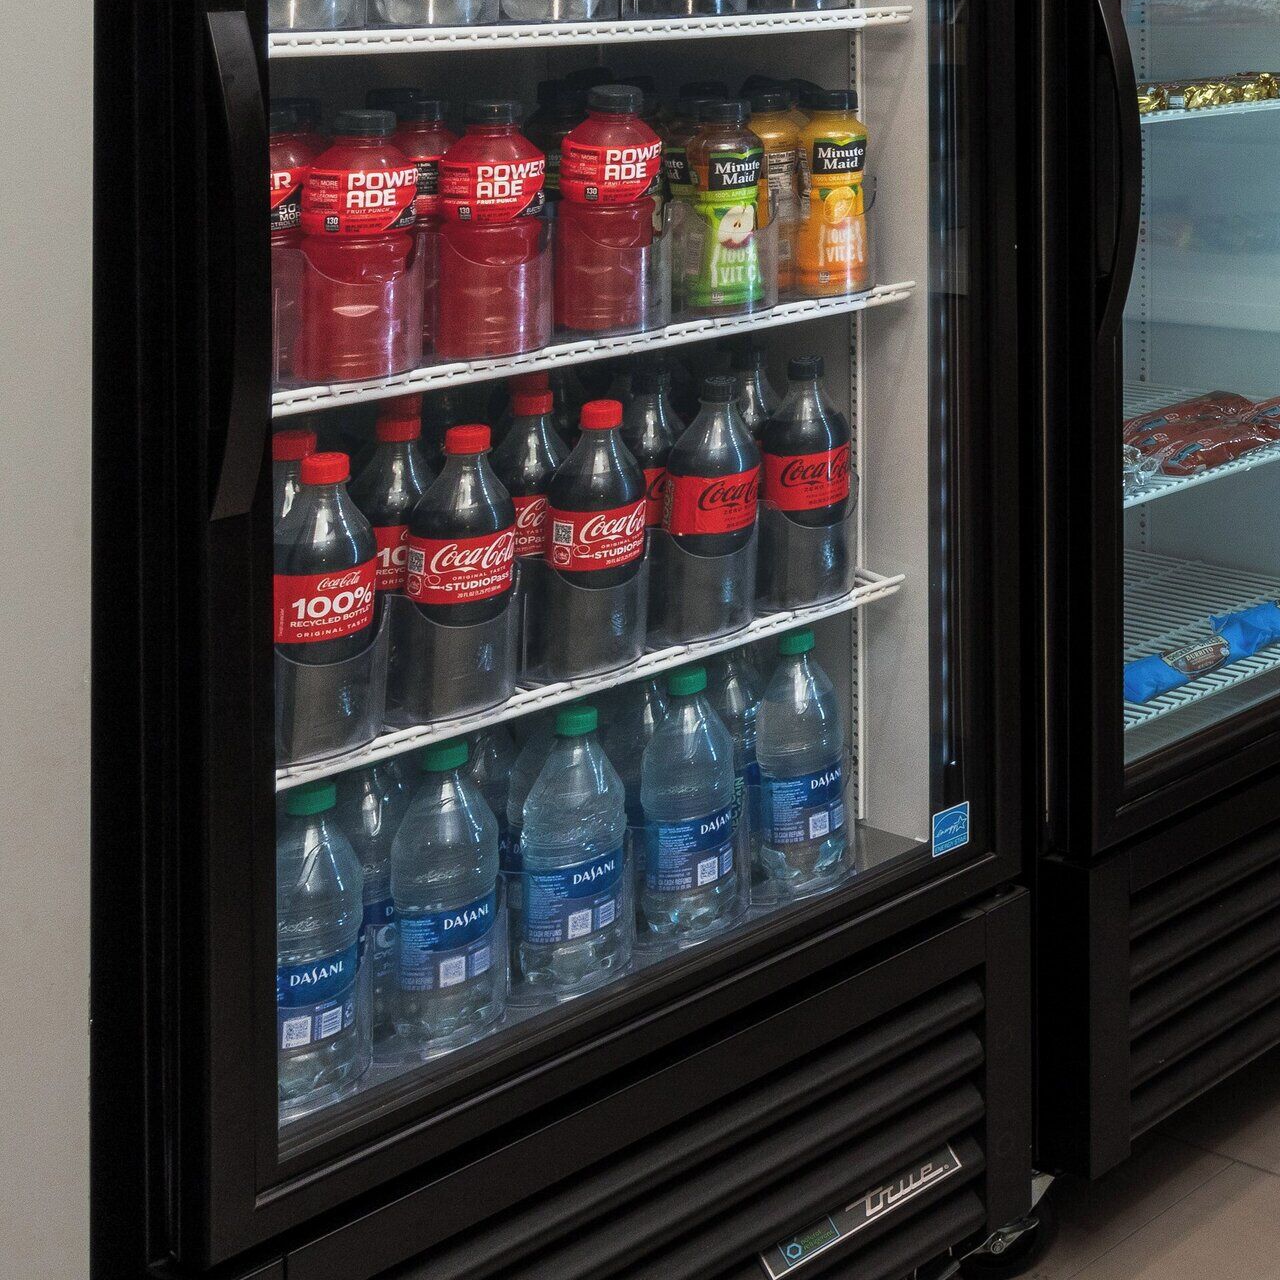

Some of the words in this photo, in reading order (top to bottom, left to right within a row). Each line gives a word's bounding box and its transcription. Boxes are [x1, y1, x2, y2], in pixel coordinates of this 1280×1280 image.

[818, 147, 864, 159] Minute
[477, 160, 545, 182] POWER
[604, 162, 647, 181] ADE
[715, 160, 760, 175] Minute
[823, 157, 858, 170] Maid
[348, 168, 419, 191] POWER
[722, 171, 755, 186] Maid
[346, 188, 396, 209] ADE
[476, 180, 524, 199] ADE
[326, 217, 339, 225] 130
[720, 266, 743, 286] VIT
[430, 528, 515, 575] Coca-Cola
[601, 538, 631, 549] ORIGINAL
[316, 570, 362, 592] Coca-Cola
[452, 571, 488, 581] ORIGINAL
[489, 565, 507, 575] TASTE
[292, 582, 372, 620] 100%
[290, 616, 342, 628] RECYCLED
[296, 627, 344, 638] ORIGINAL
[1185, 647, 1214, 662] BURRITO
[572, 859, 616, 886] DASANI
[443, 905, 490, 931] DASANI
[290, 960, 345, 987] DASANI
